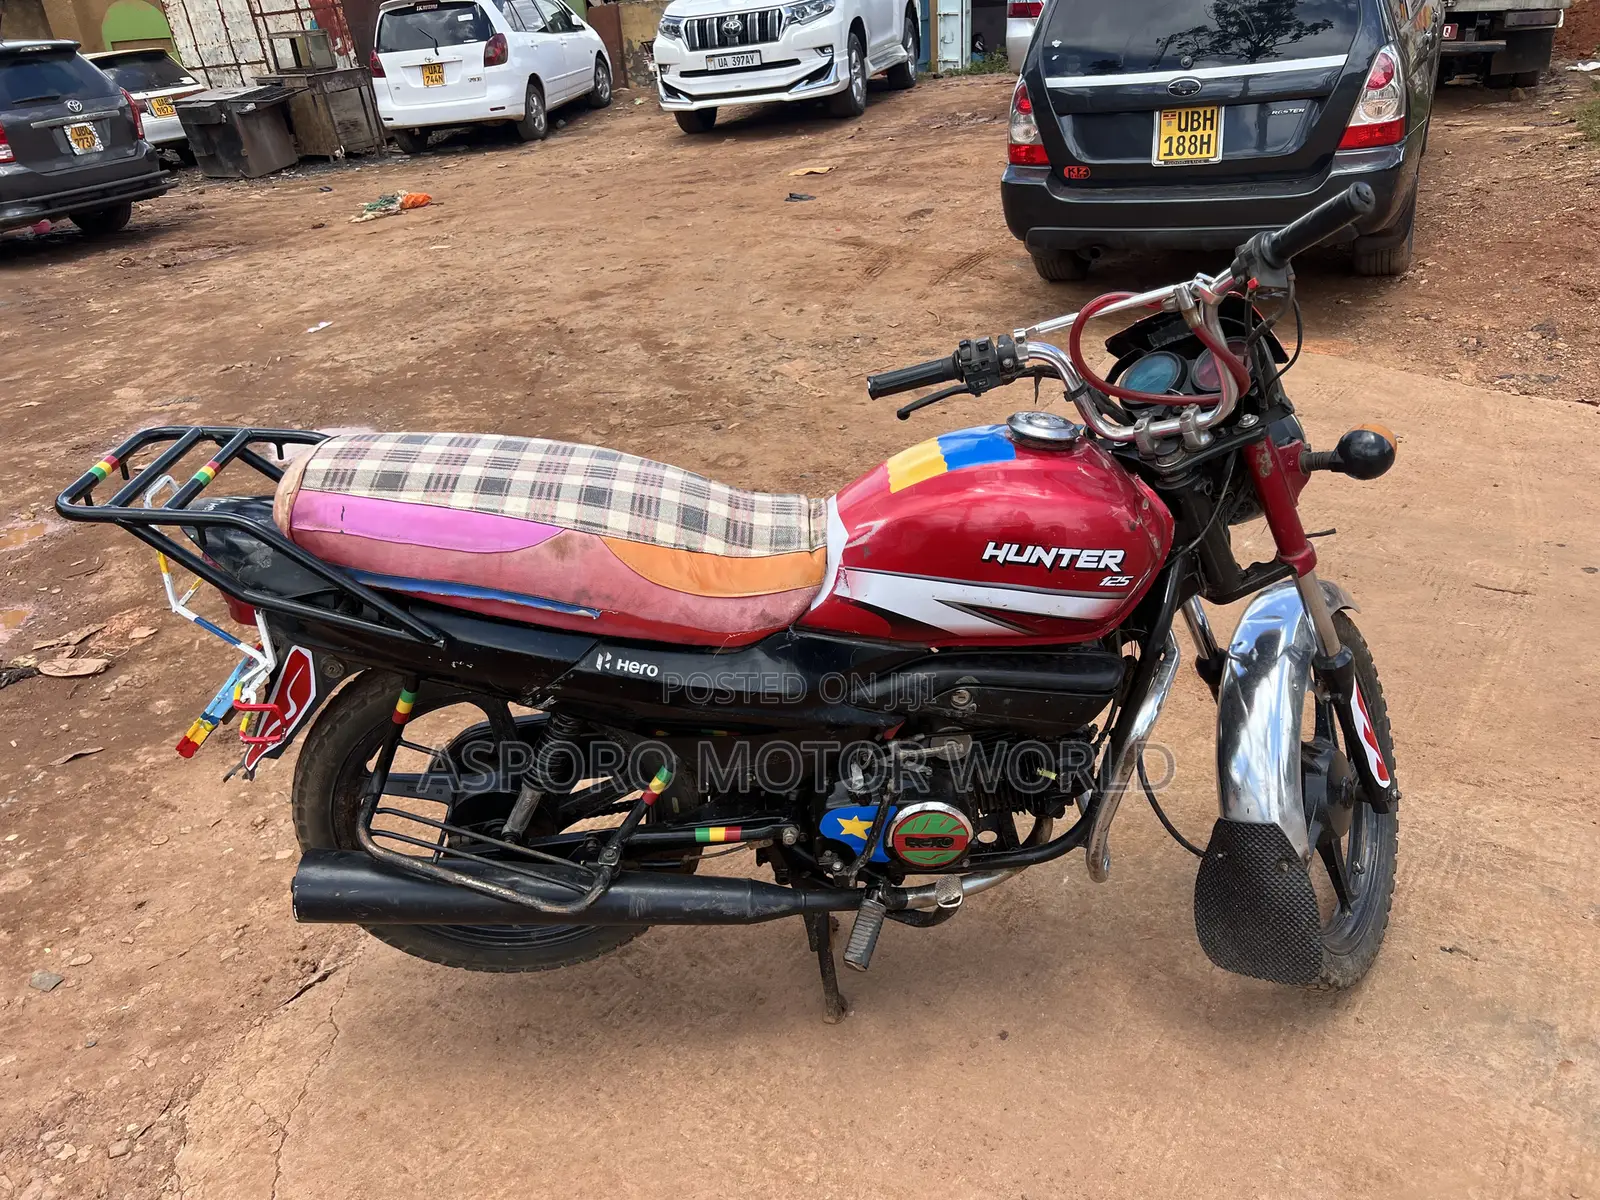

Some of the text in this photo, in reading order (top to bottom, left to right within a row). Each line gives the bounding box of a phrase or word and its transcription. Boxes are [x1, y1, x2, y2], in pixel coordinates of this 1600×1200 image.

[428, 64, 442, 74] UAZ
[717, 54, 755, 68] UA 397AY
[1177, 109, 1215, 132] UBH
[1163, 133, 1212, 156] 188H
[982, 541, 1125, 572] HUNTER
[1099, 576, 1134, 587] 125
[616, 658, 659, 677] Hero
